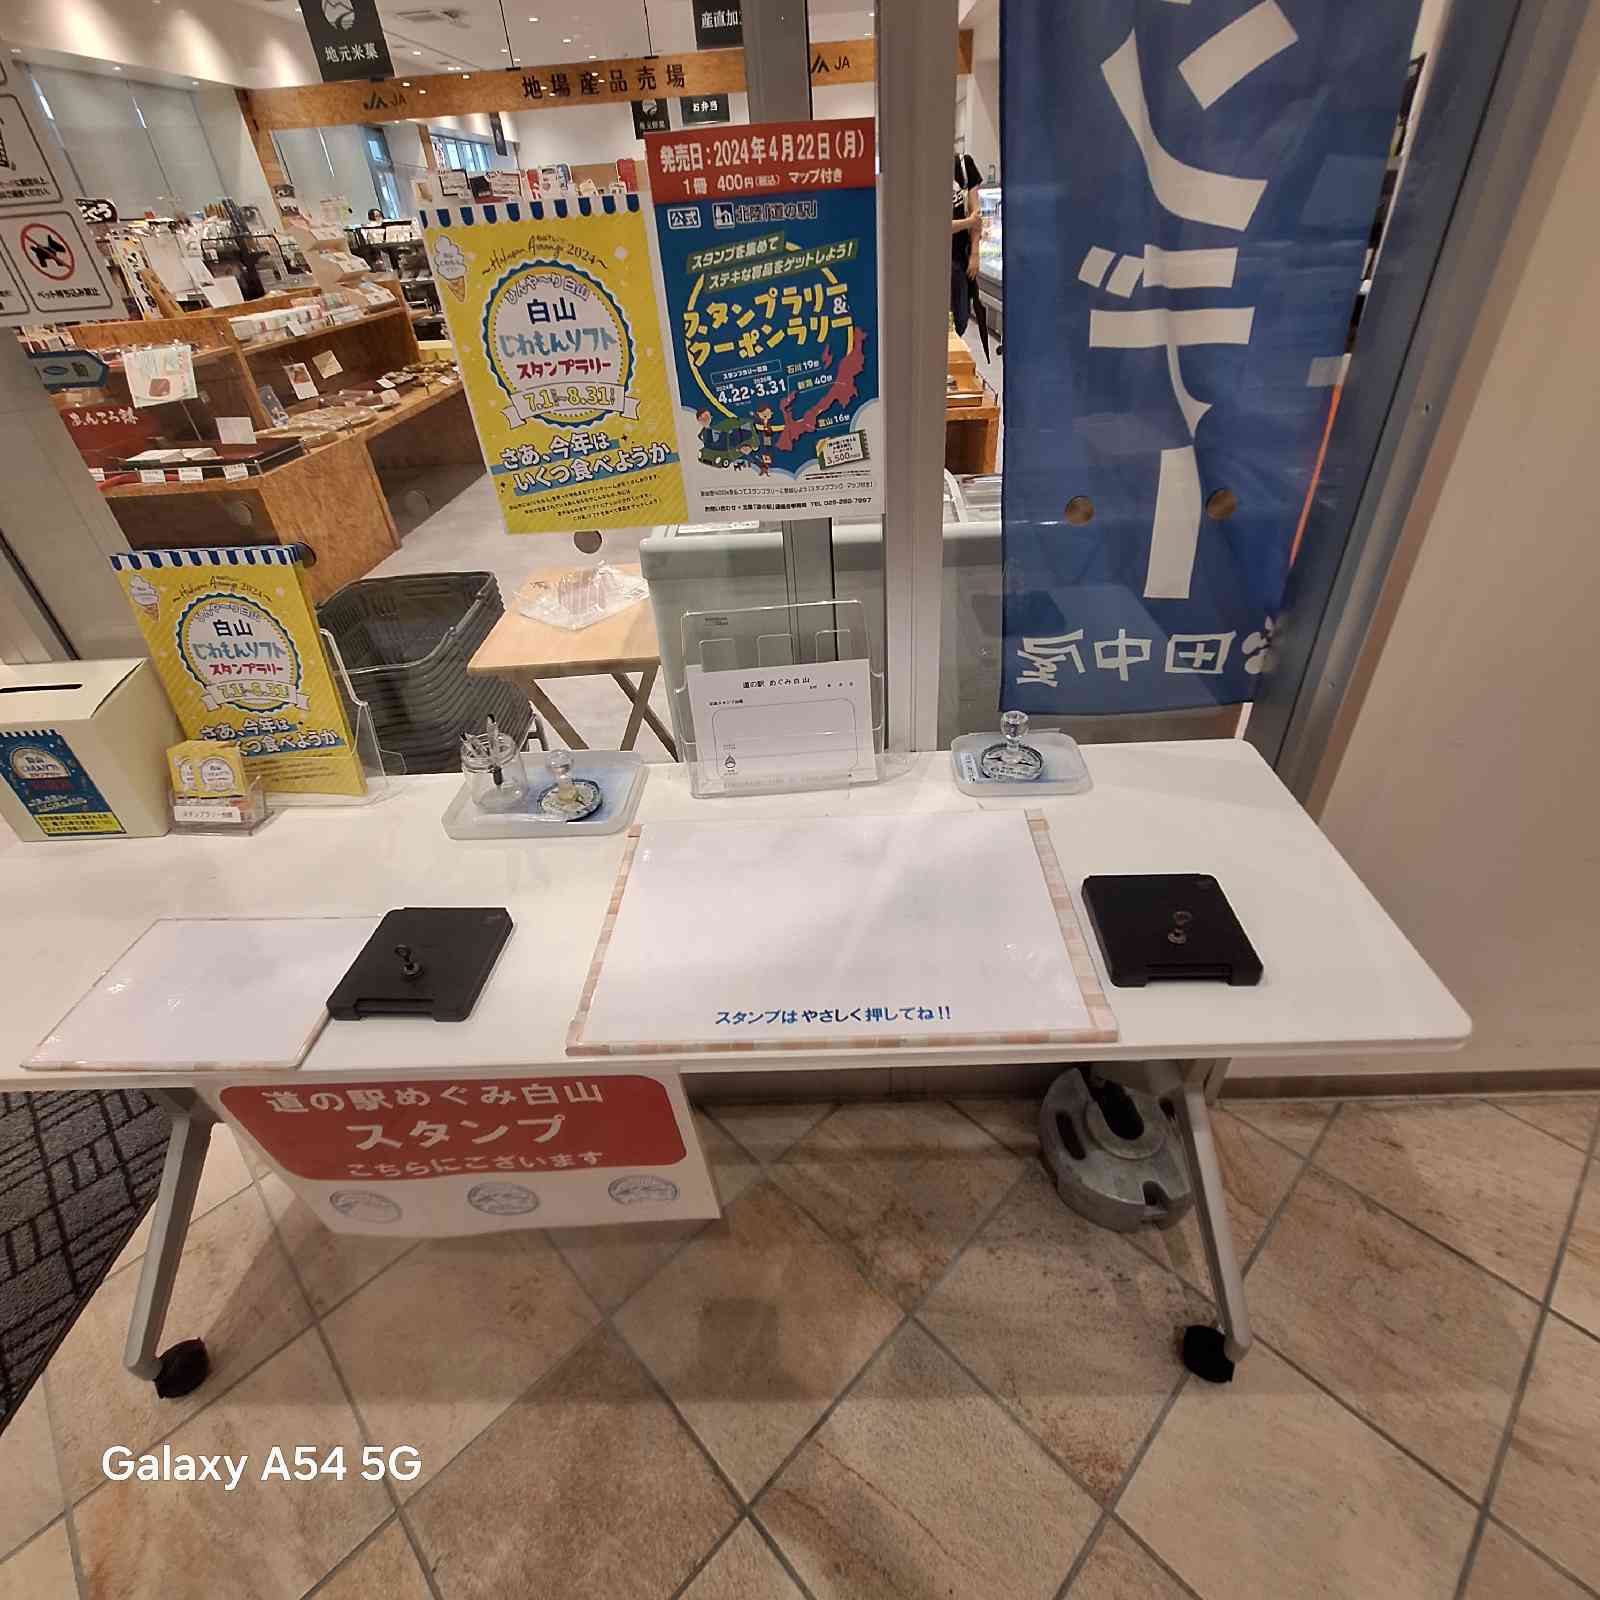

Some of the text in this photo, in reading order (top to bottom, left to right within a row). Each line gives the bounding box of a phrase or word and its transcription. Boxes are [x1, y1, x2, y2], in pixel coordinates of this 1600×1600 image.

[701, 10, 742, 30] 産直加
[325, 43, 380, 63] 地元米菓
[835, 57, 850, 71] JA
[522, 64, 687, 99] 地場産品売場
[692, 101, 719, 114] お弁当
[788, 168, 843, 185] マップ付き
[671, 210, 700, 227] 公式
[692, 237, 780, 269] スタンプを集めて
[527, 297, 577, 324] 白山
[683, 283, 848, 338] スタンプラリー
[499, 328, 617, 358] じわもんソフト
[688, 317, 853, 367] クーポンラリー
[516, 360, 612, 380] スタンプラリー
[501, 432, 611, 470] さあ、今年は
[514, 442, 671, 493] いくつ食べようか
[212, 618, 254, 637] 白山
[192, 641, 287, 660] じわもんソフト
[209, 662, 284, 676] スタンプラリー
[201, 717, 290, 741] さあ、今年は
[238, 729, 338, 756] くつ食べようか
[262, 1081, 605, 1114] 道の駅めぐみ白山
[345, 1114, 566, 1151] スタンプ
[347, 1151, 605, 1179] こちらにございます
